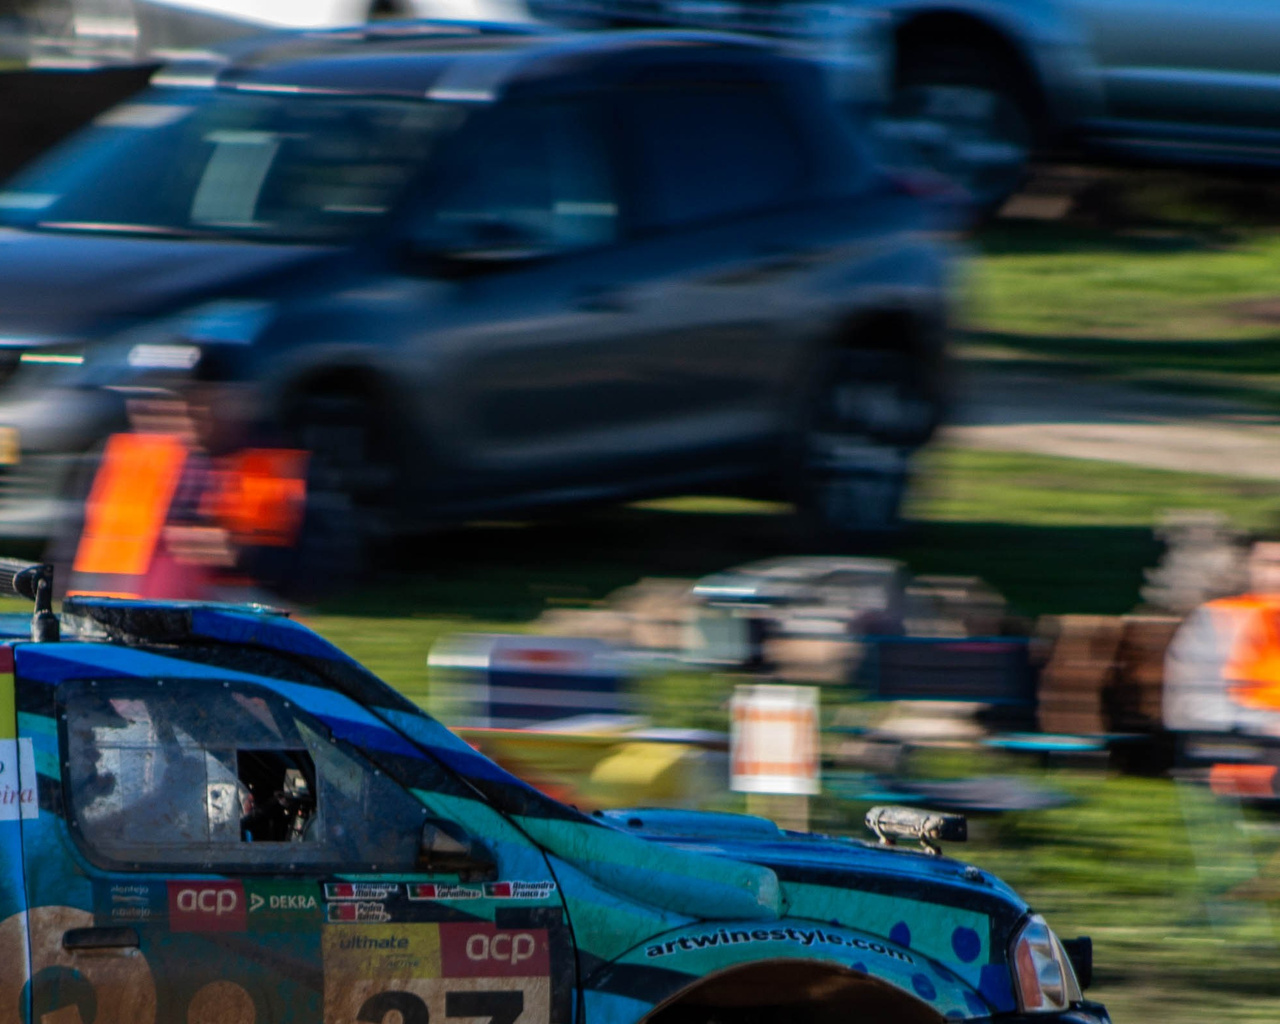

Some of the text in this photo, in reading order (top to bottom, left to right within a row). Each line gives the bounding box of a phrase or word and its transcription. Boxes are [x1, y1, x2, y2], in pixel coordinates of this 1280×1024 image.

[177, 889, 237, 916] acp
[270, 896, 318, 909] DEKRA
[339, 935, 410, 950] ultimate
[465, 933, 536, 965] acp
[646, 927, 917, 966] artwinestyle.com
